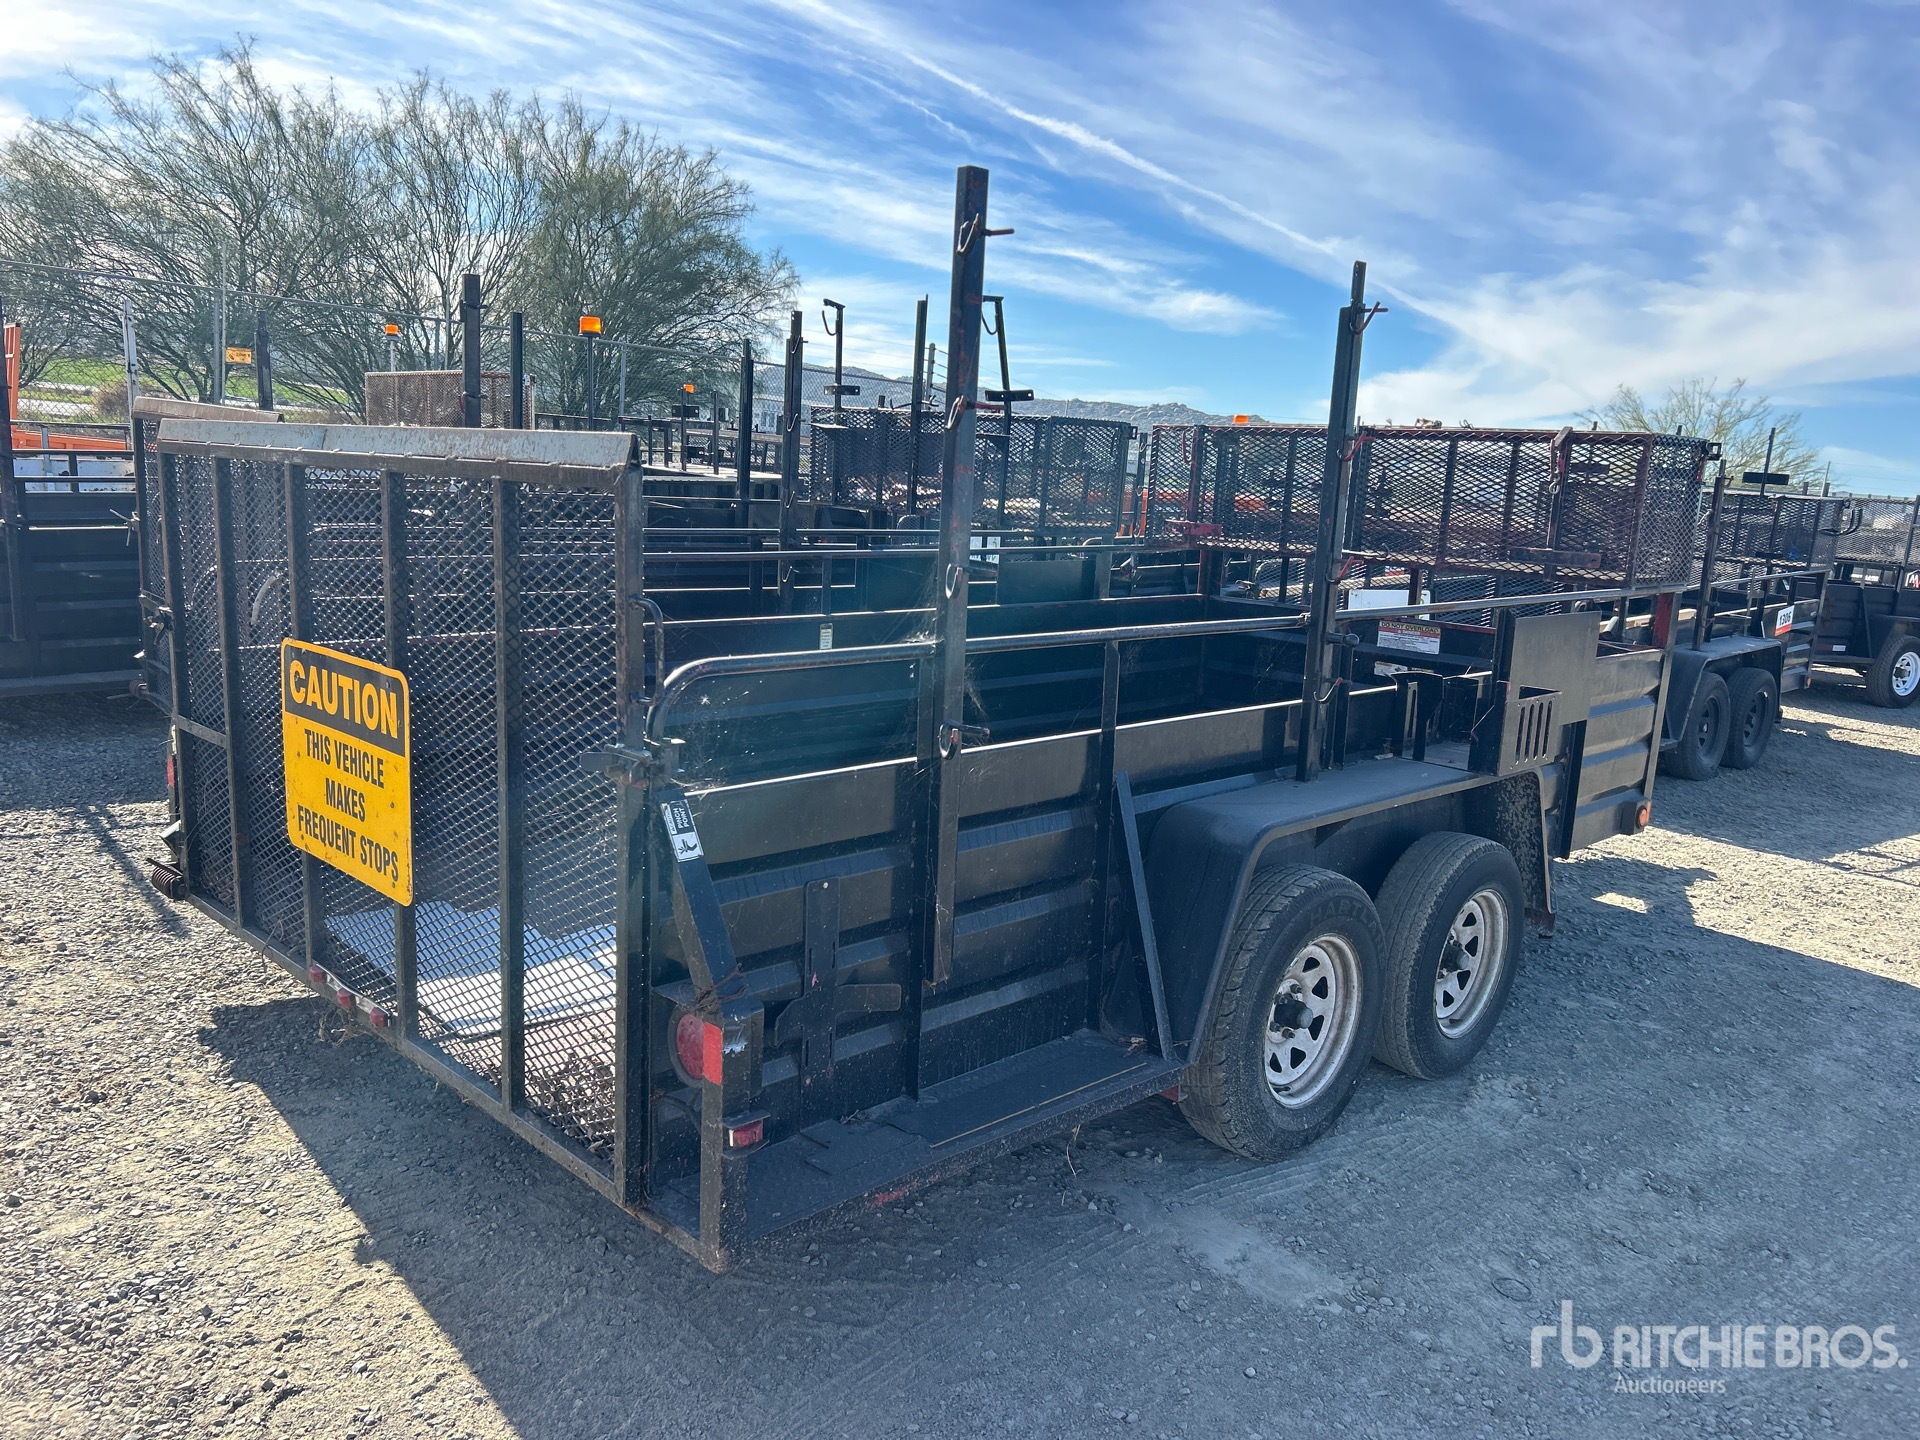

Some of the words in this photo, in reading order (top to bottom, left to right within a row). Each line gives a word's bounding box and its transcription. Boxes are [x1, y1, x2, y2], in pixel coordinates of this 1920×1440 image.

[1405, 624, 1440, 633] OVERLOAD
[289, 659, 398, 739] CAUTION
[304, 728, 332, 765] THIS
[334, 739, 385, 789] VEHICLE
[325, 777, 366, 823] MAKES
[673, 807, 684, 829] PINCH
[679, 807, 690, 828] POINT
[297, 804, 357, 860] FREQUENT
[360, 835, 399, 882] STOPS
